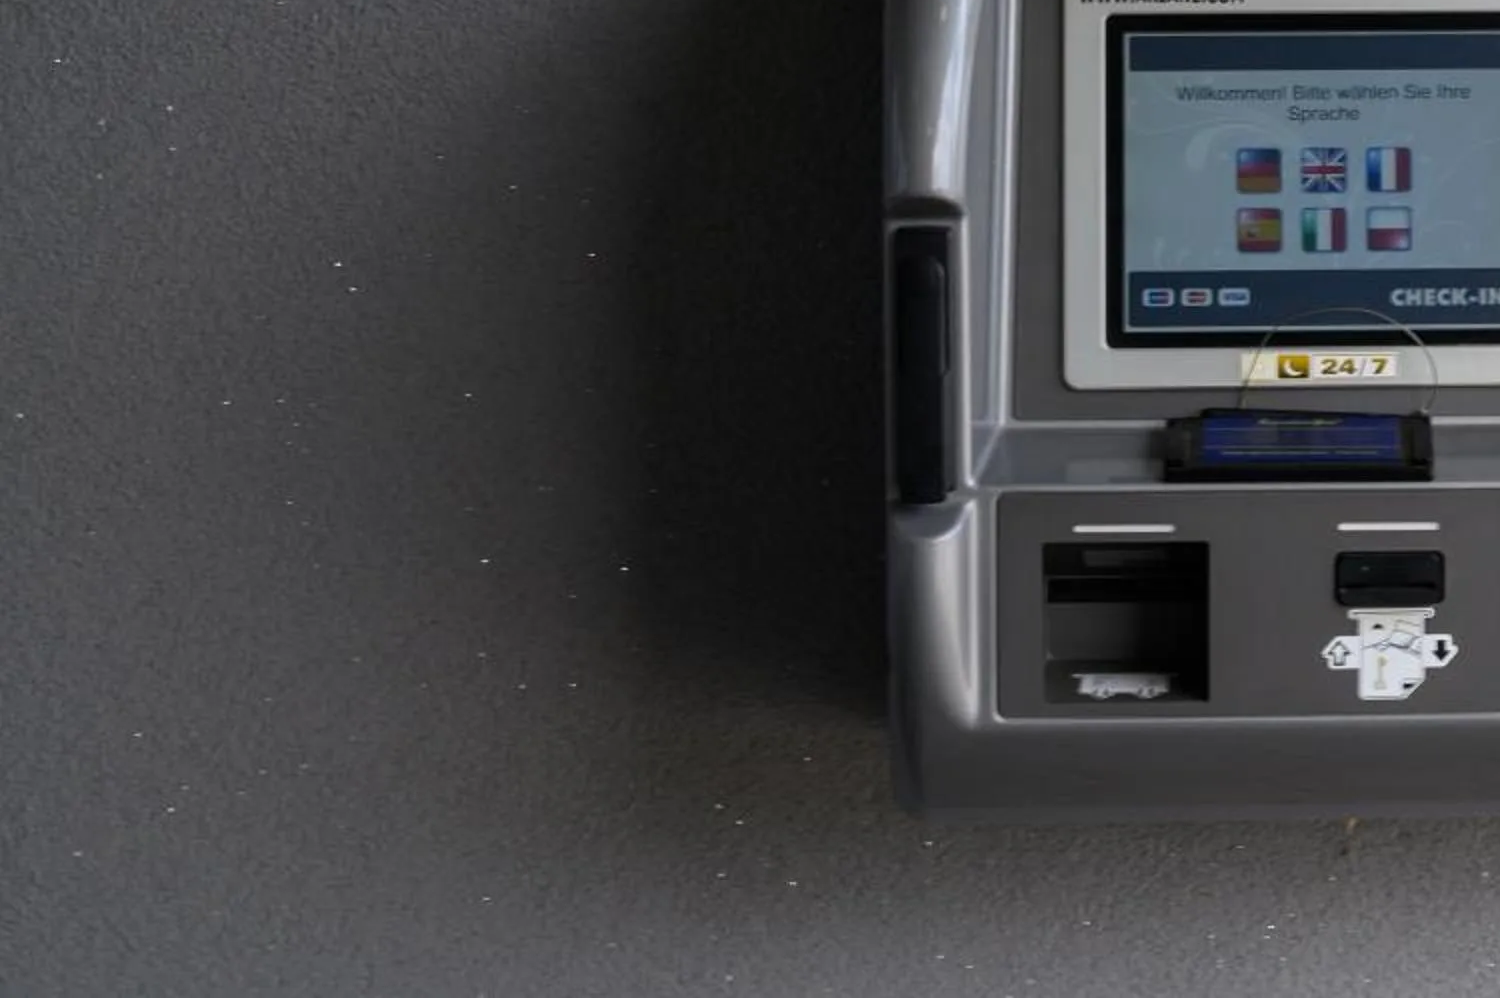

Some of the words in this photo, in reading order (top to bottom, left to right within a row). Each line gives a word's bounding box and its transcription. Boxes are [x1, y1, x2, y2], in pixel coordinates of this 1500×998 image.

[1175, 85, 1287, 102] Willkommen!
[1292, 84, 1331, 101] Bitte
[1335, 83, 1400, 100] wählen
[1403, 83, 1432, 100] Sie
[1436, 83, 1472, 100] Ihre
[1286, 105, 1361, 124] Sprache
